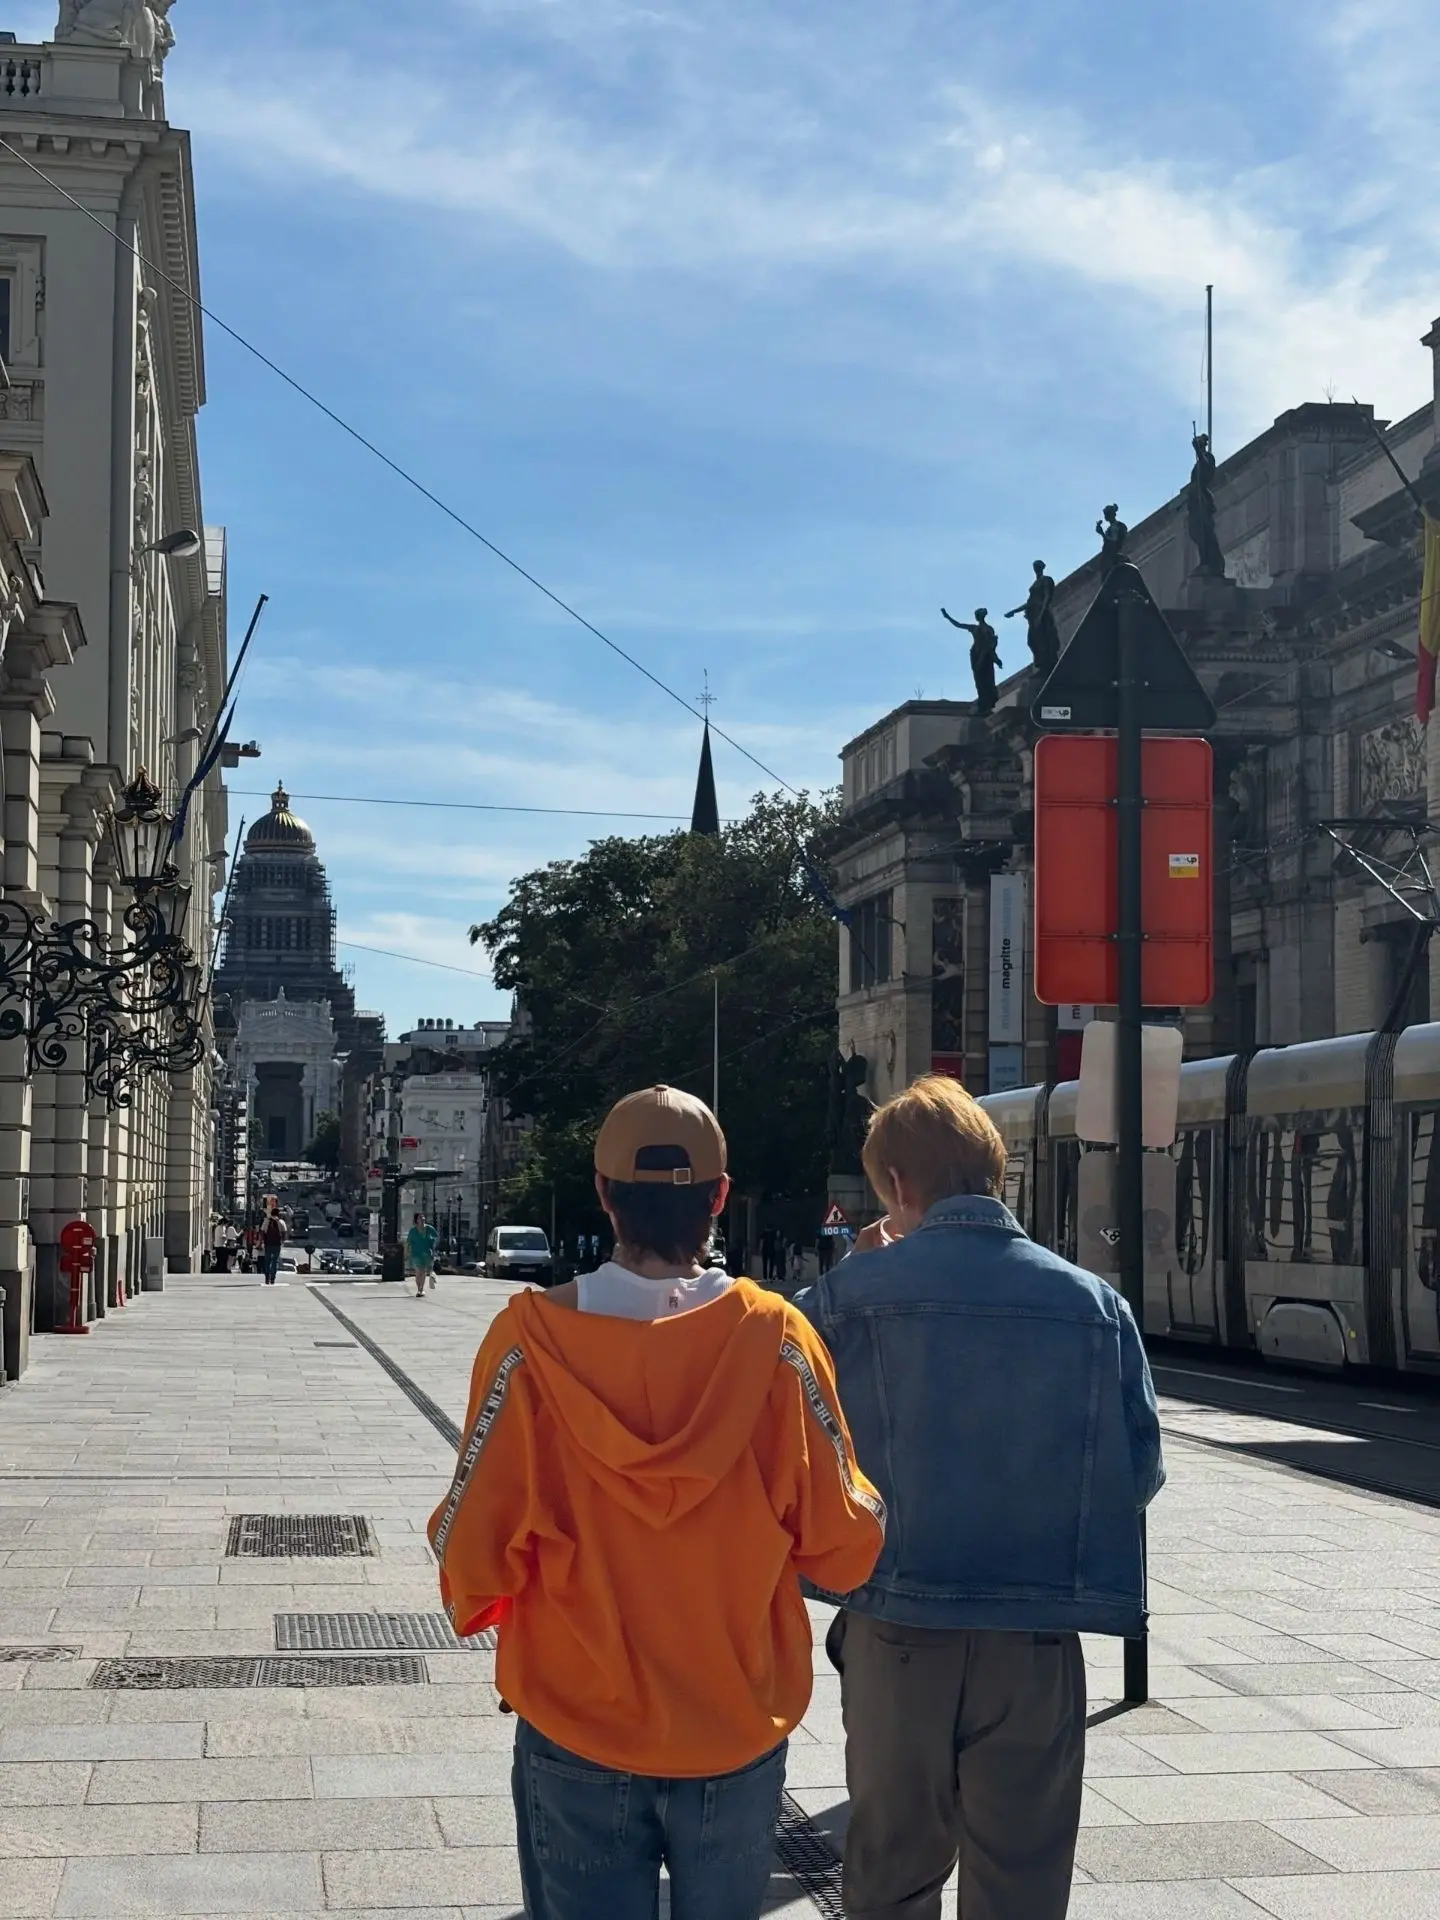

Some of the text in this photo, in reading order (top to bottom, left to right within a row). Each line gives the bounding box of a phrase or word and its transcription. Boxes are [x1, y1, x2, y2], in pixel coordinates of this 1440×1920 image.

[1000, 938, 1013, 989] magritte
[823, 1226, 839, 1236] 100
[495, 1378, 506, 1392] IS
[793, 1354, 820, 1401] FUTURE
[487, 1394, 502, 1409] IN
[813, 1401, 833, 1427] THE
[475, 1411, 495, 1436] THE
[462, 1436, 483, 1473] PAST
[449, 1479, 465, 1504] THE
[435, 1504, 455, 1556] FUTURE
